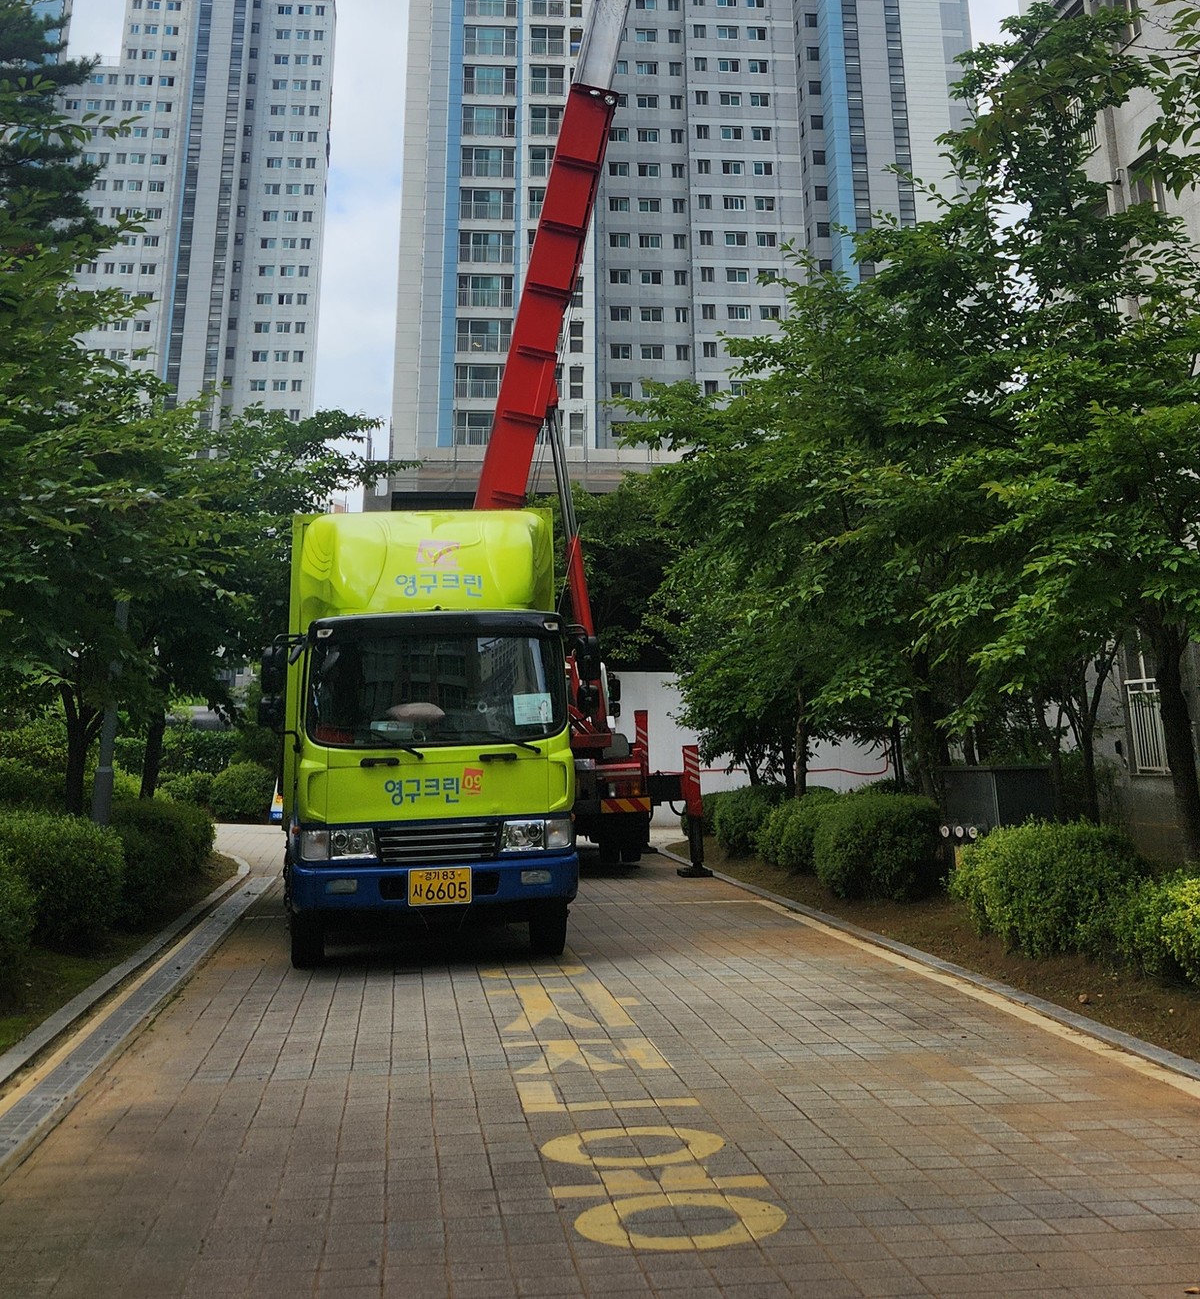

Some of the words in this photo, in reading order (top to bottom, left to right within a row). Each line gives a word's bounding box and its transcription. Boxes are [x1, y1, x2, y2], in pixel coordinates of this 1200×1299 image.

[395, 574, 483, 597] 영구크린
[384, 777, 460, 805] 영구크린
[464, 774, 482, 790] 09
[424, 871, 440, 881] 경기
[441, 870, 456, 880] 83
